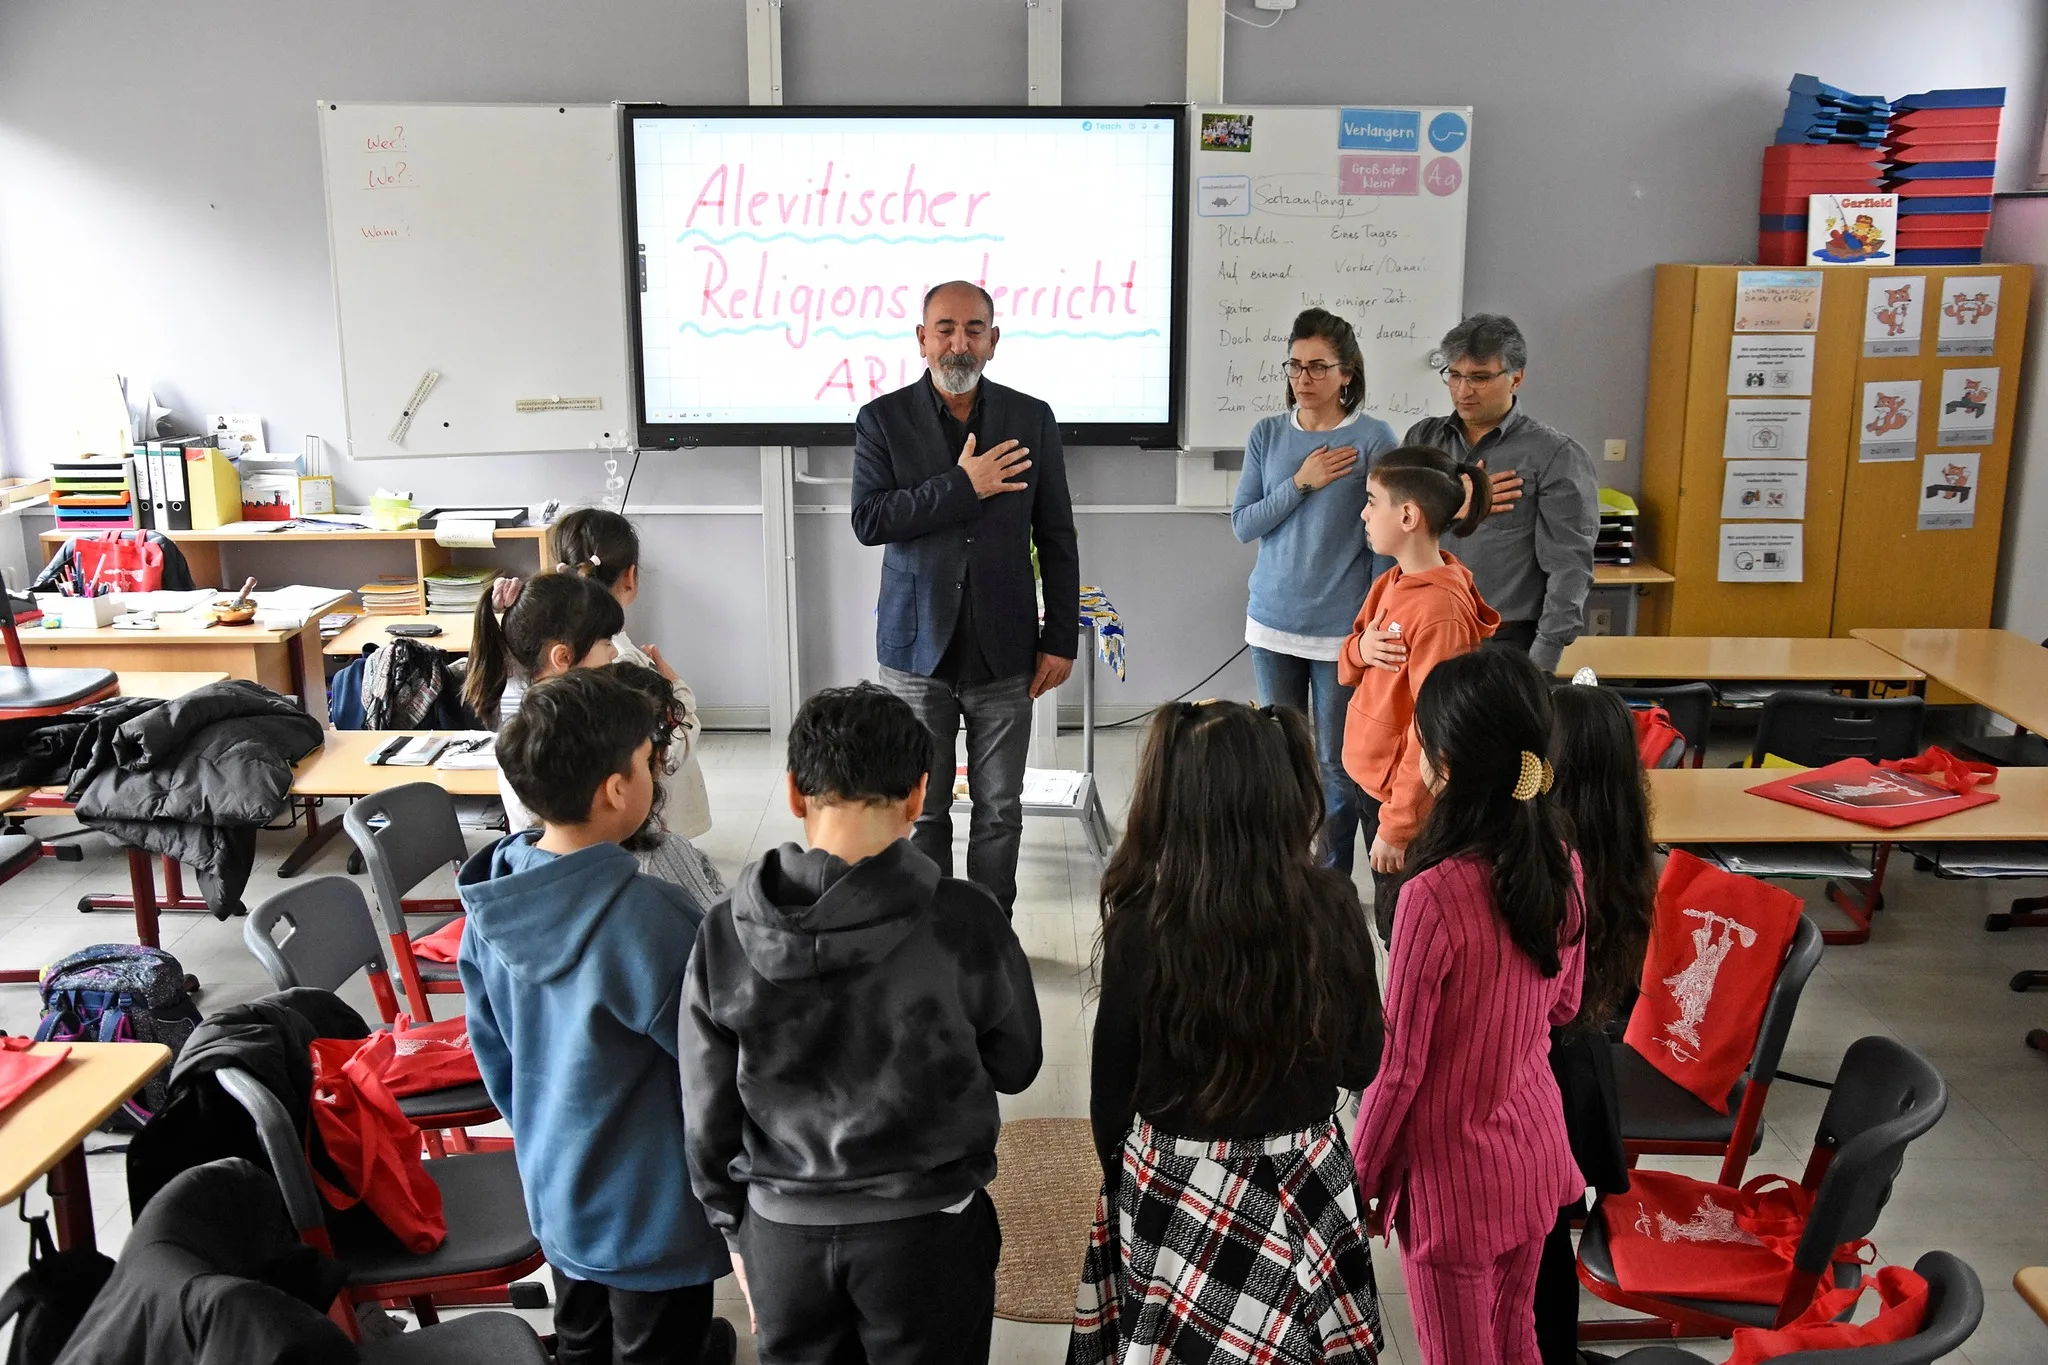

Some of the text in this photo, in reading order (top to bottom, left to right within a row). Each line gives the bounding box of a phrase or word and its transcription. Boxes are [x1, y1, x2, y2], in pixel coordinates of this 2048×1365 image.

[1096, 122, 1121, 130] Teach
[1352, 163, 1408, 175] Groß oder
[1363, 176, 1396, 189] klein?
[685, 161, 991, 227] Alevitischer
[1841, 198, 1893, 208] Garfield
[1251, 264, 1292, 280] einmal
[1220, 326, 1252, 347] Doch
[1217, 396, 1246, 412] Zum
